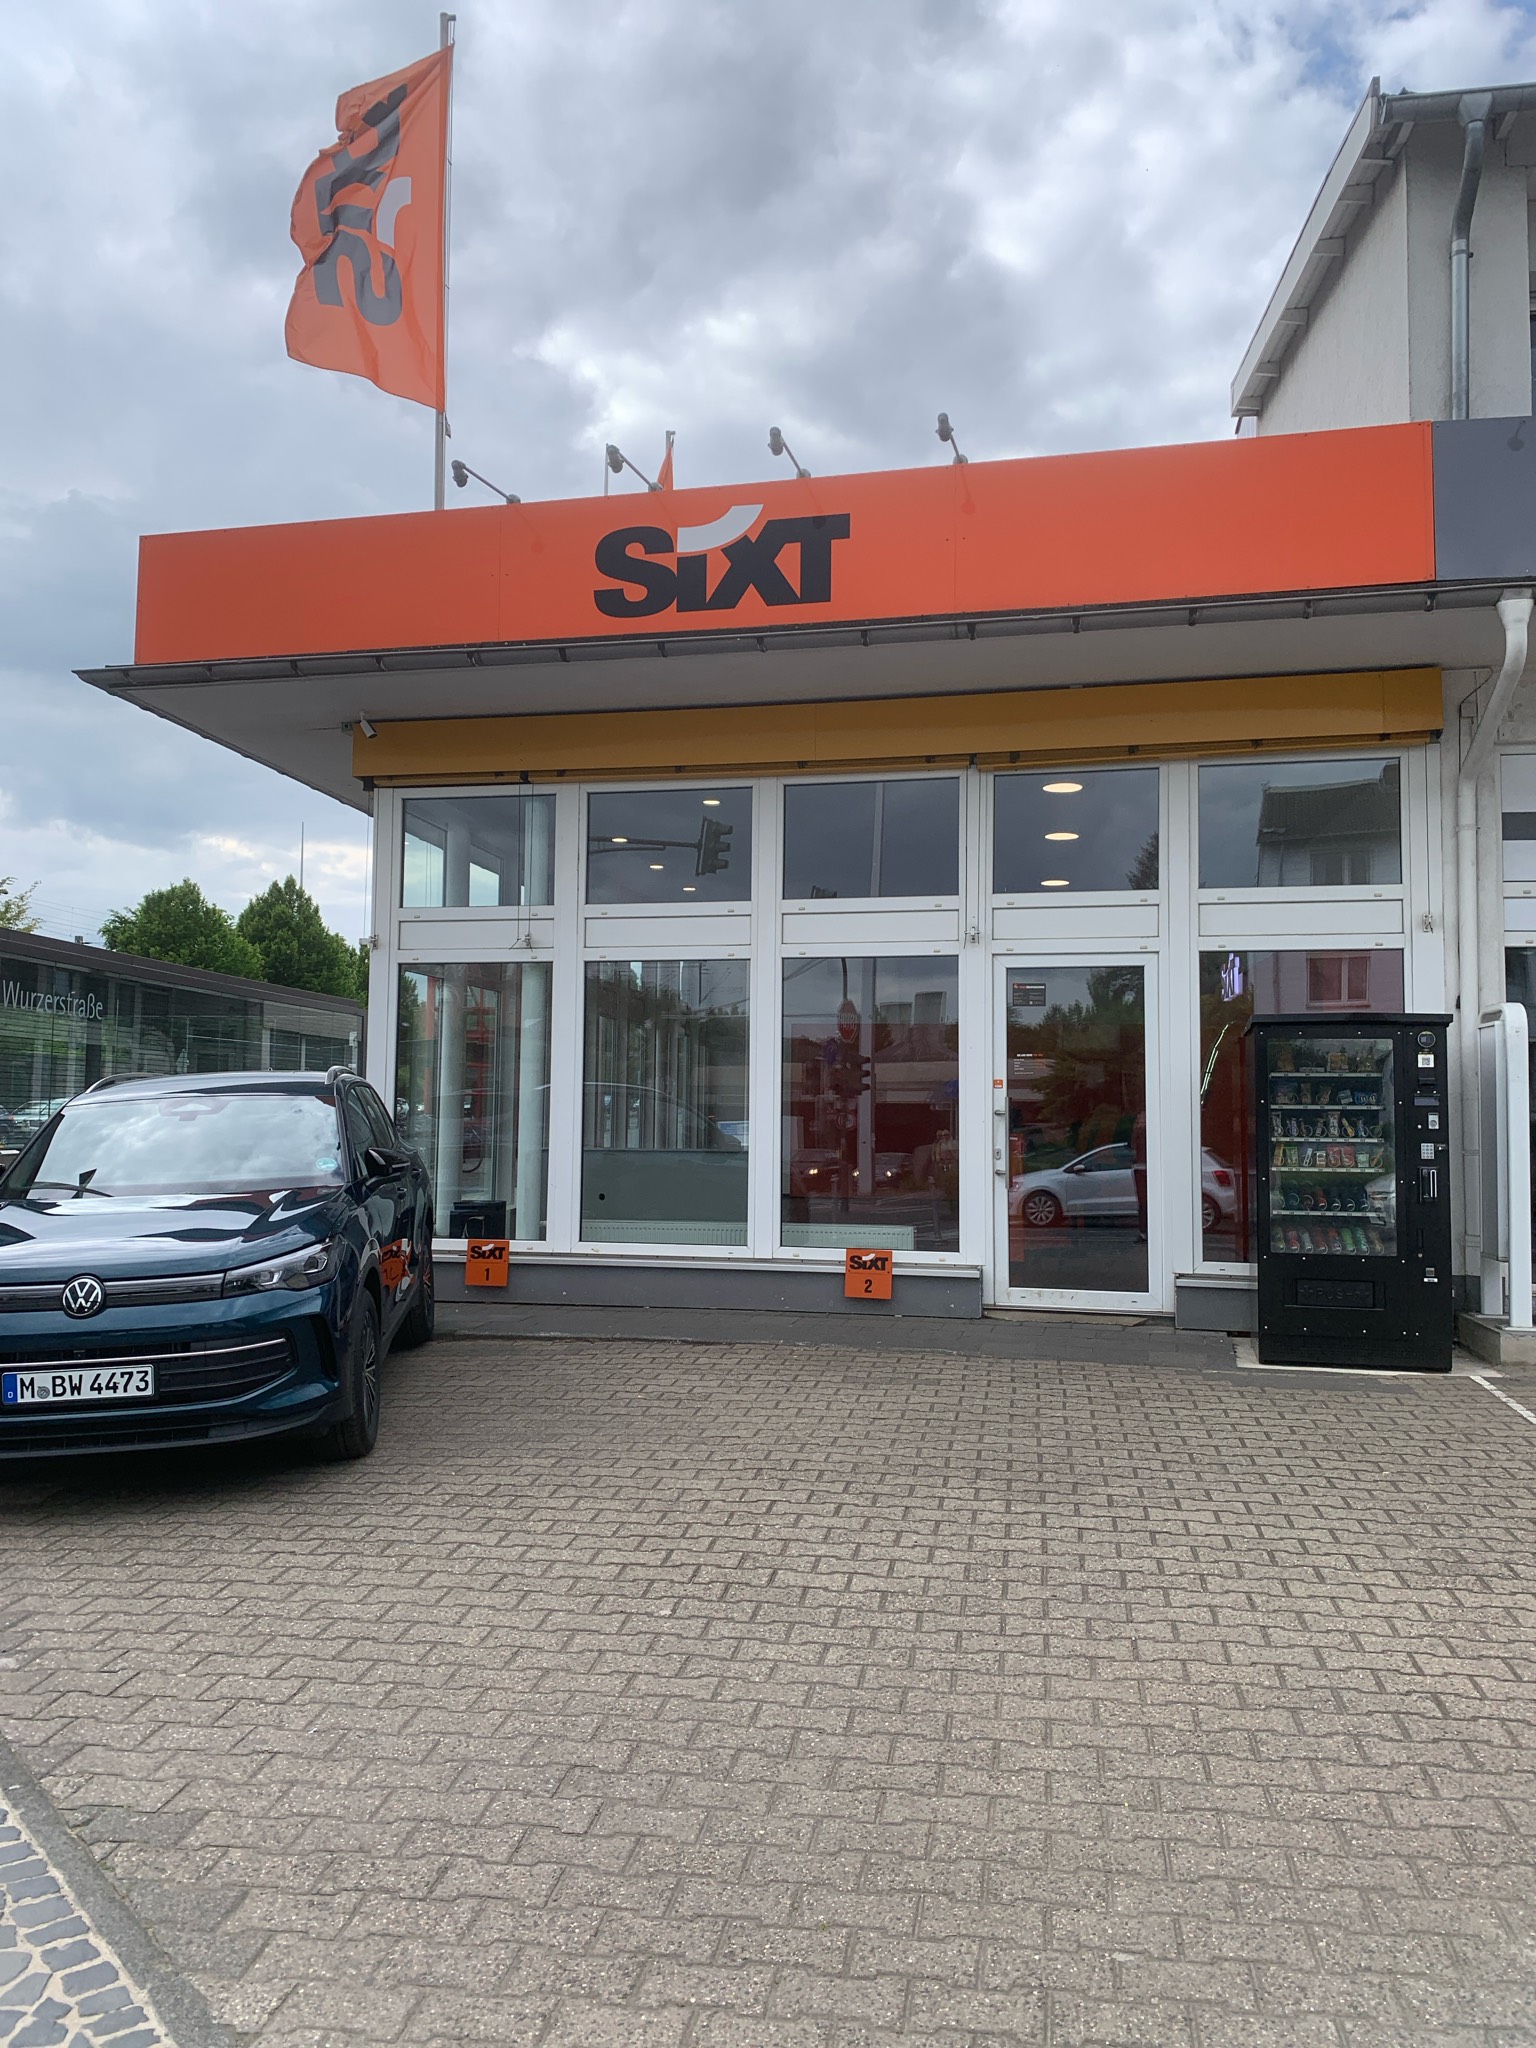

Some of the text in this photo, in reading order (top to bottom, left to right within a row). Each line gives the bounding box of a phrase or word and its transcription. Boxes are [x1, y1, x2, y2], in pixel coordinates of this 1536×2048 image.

[2, 979, 103, 1020] Wurzerstraße
[485, 1267, 490, 1281] 1
[864, 1279, 873, 1293] 2
[19, 1370, 149, 1400] M BW 4473
